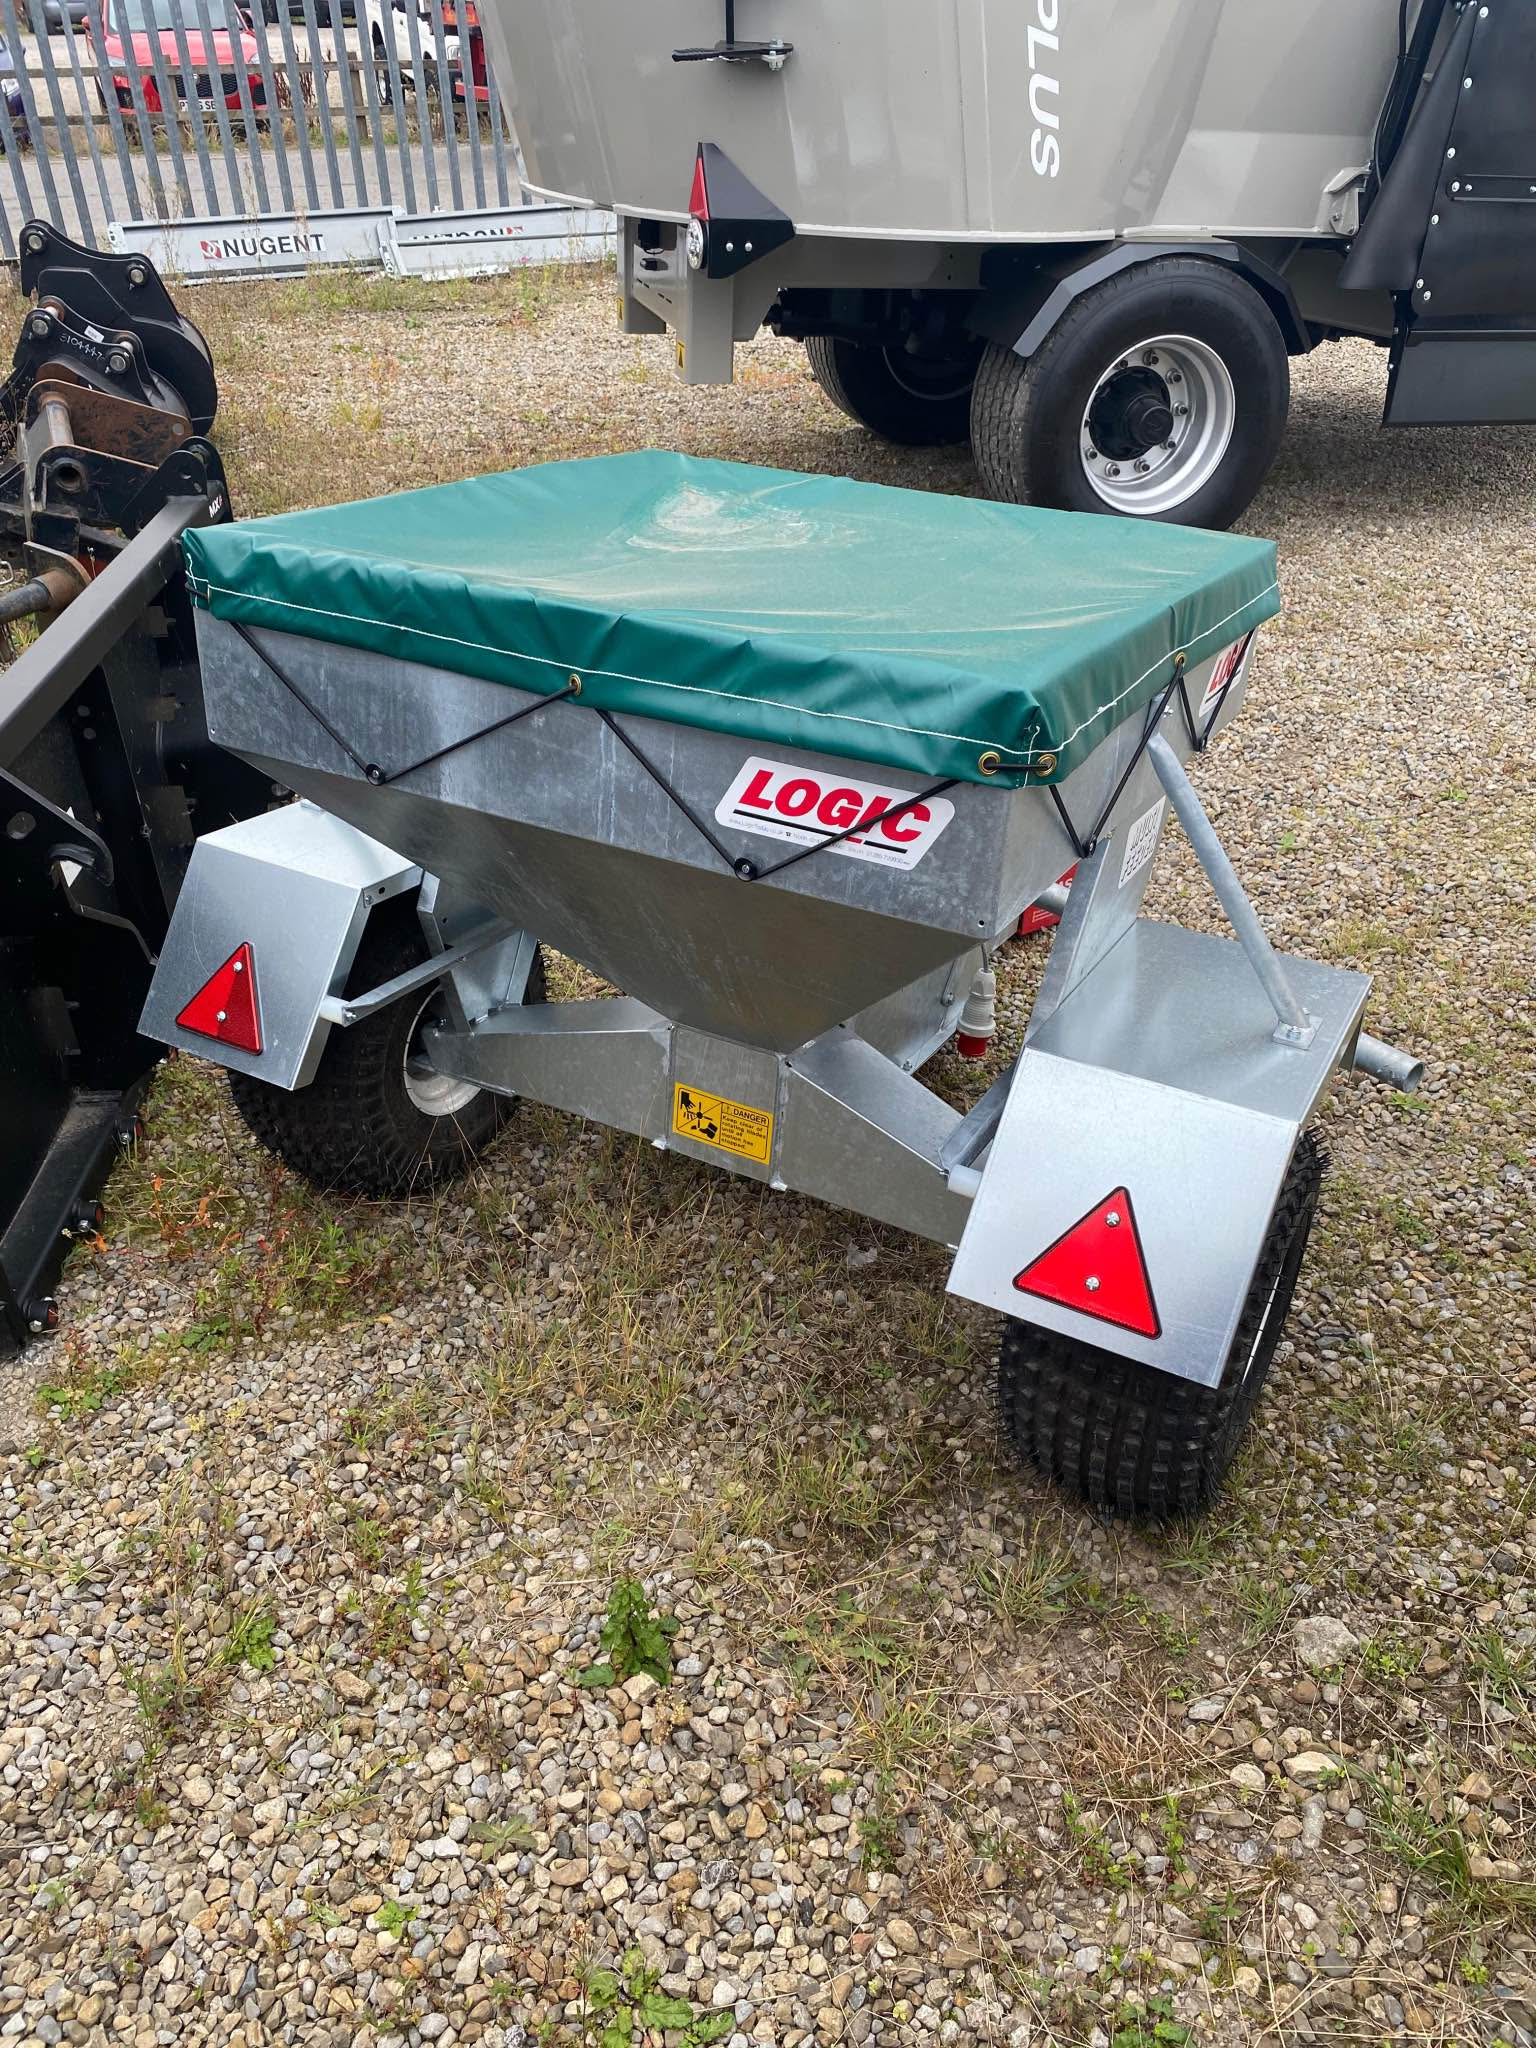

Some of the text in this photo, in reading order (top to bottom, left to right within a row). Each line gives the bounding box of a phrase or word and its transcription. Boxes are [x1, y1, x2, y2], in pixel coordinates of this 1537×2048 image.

[223, 234, 324, 258] NUGENT
[738, 769, 931, 843] LOGIC
[733, 1109, 767, 1124] DANGER
